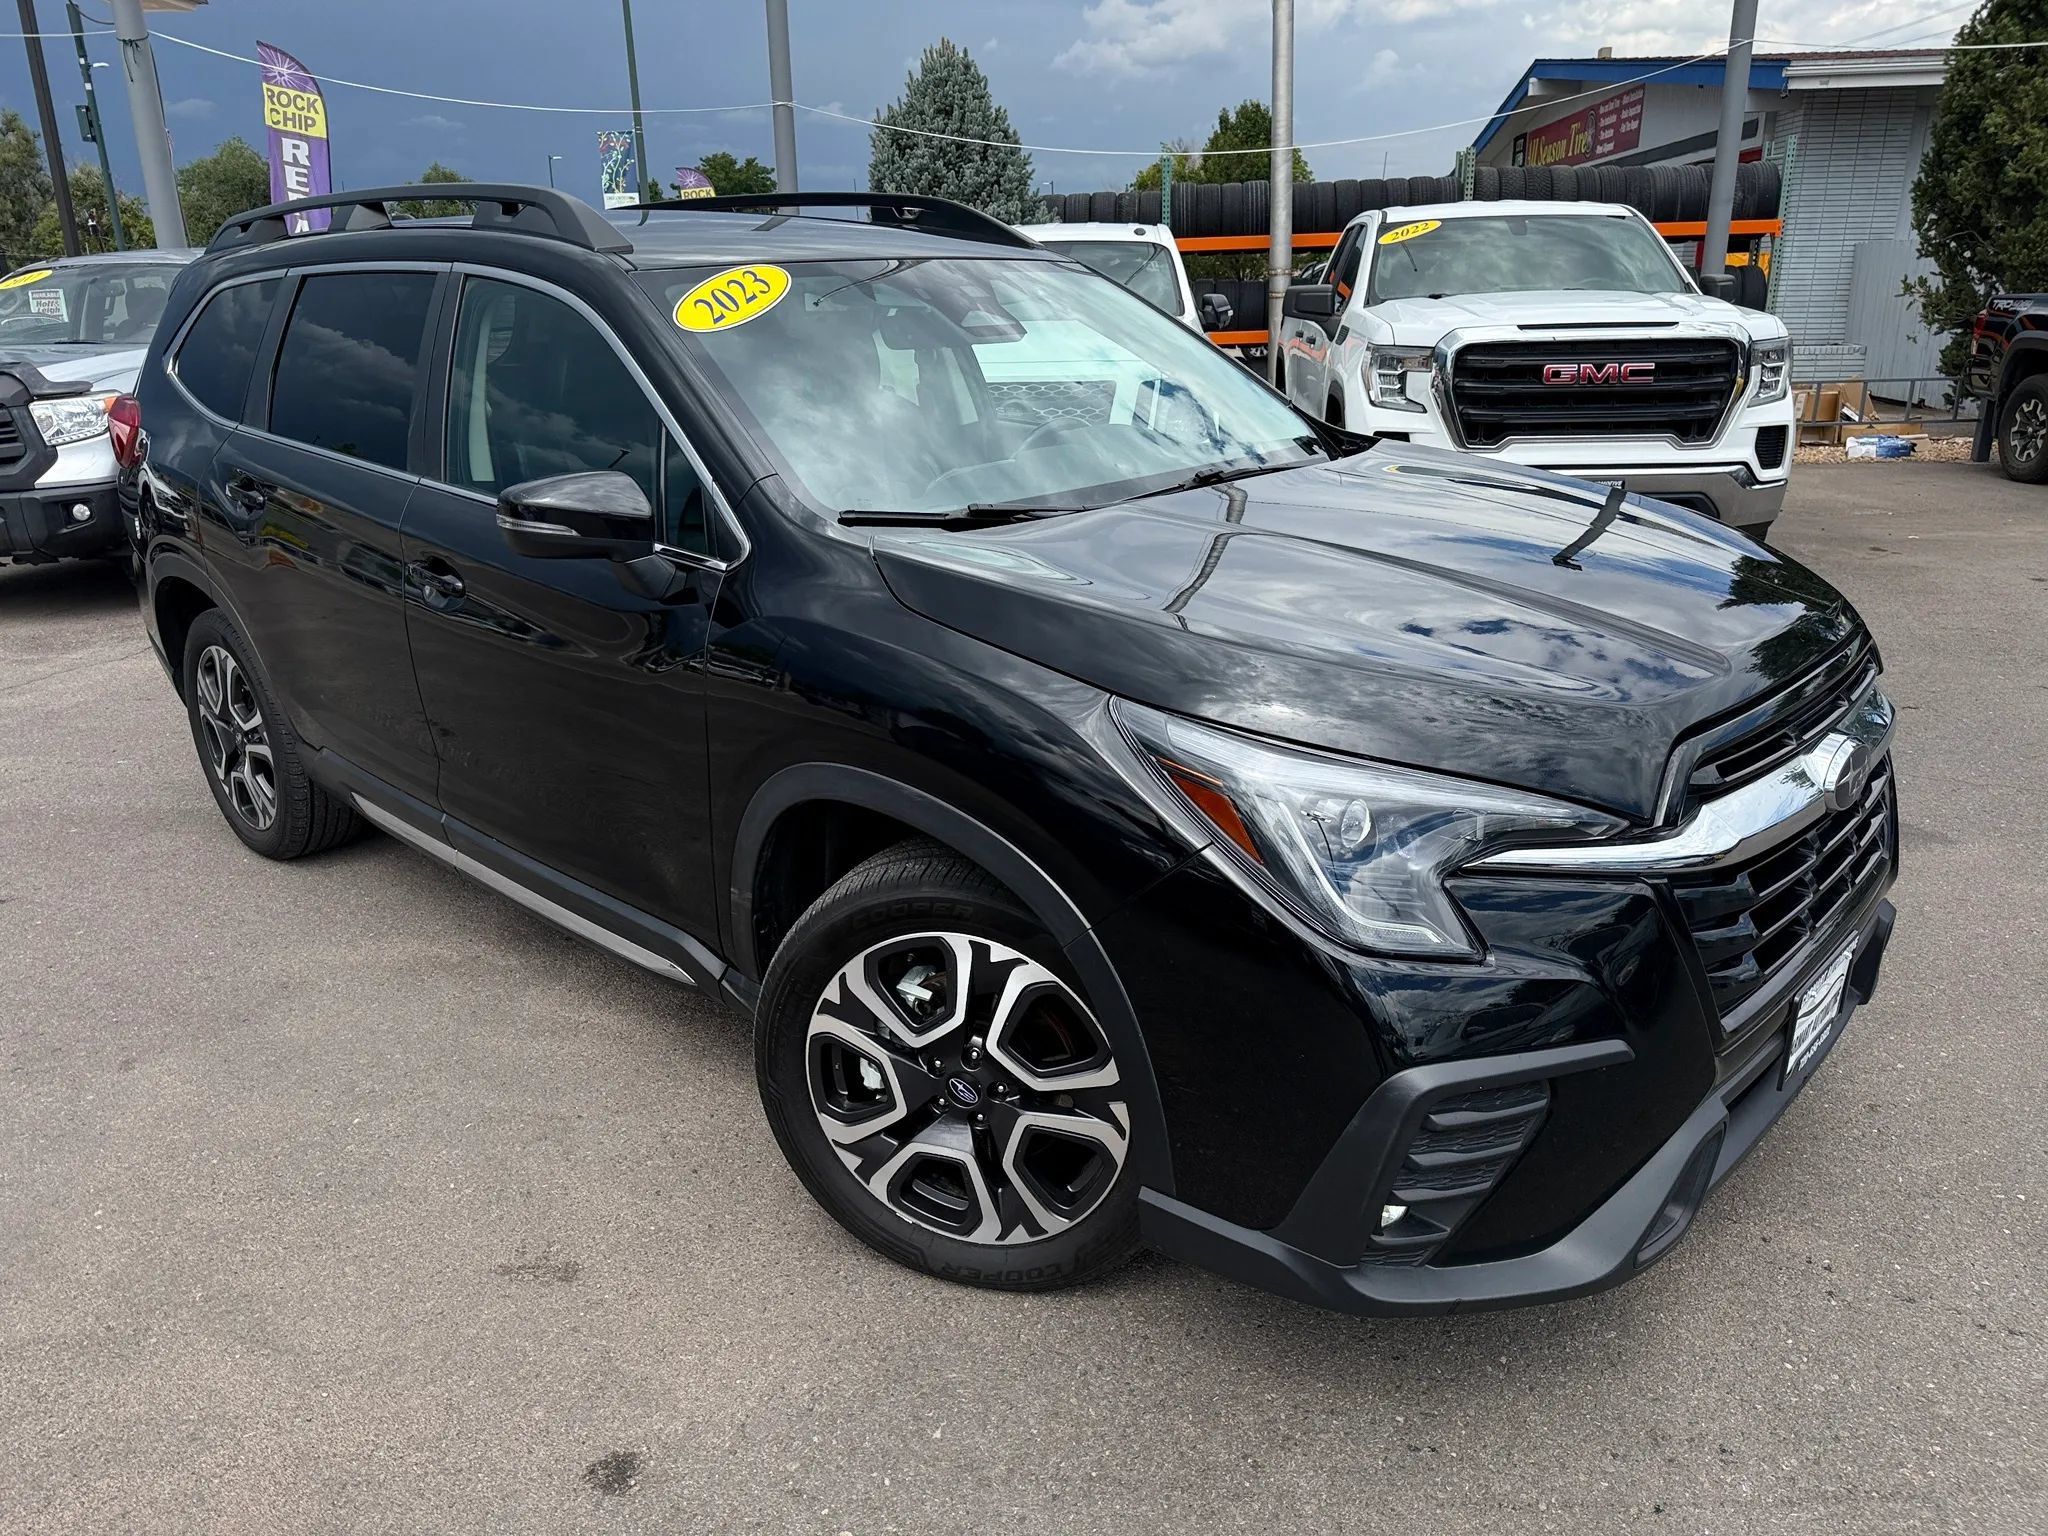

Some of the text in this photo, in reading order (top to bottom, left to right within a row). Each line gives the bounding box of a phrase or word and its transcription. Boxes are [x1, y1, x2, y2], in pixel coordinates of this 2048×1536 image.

[265, 87, 320, 115] ROCK
[269, 107, 317, 132] CHIP
[1538, 136, 1567, 165] Season
[683, 188, 713, 200] ROCK
[1391, 222, 1430, 241] 2022
[693, 270, 771, 325] 2023
[1543, 363, 1656, 384] GMC
[941, 1262, 1062, 1282] COOPER
